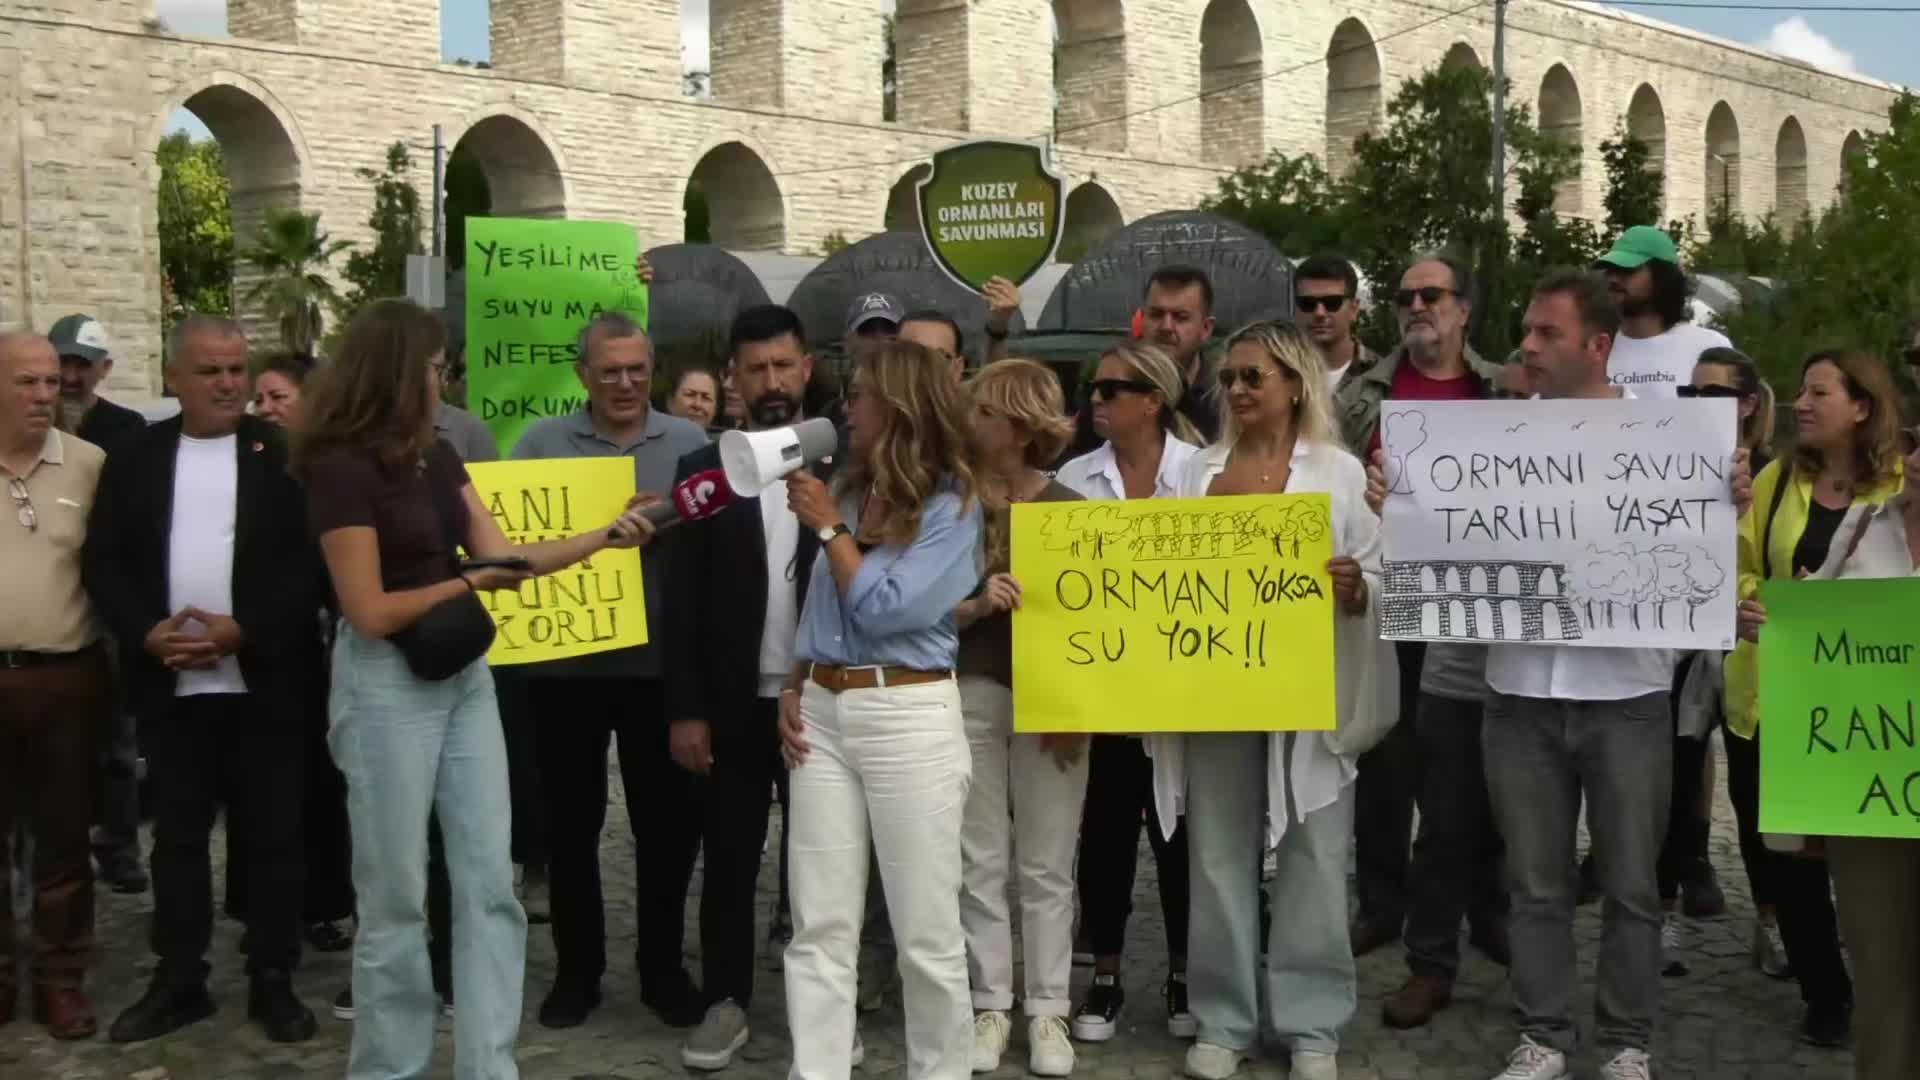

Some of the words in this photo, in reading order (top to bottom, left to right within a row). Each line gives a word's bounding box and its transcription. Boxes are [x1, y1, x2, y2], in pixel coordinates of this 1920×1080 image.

[961, 182, 1018, 201] KUZEY
[938, 201, 1045, 222] ORMANLARI
[939, 220, 1046, 243] SAVUNMASI
[1613, 371, 1676, 385] Columbia
[1430, 452, 1585, 492] ORMANI
[1605, 452, 1724, 482] SAVUN
[1434, 500, 1577, 543] TARİHİ
[1606, 494, 1721, 537] YAŞAT
[1055, 568, 1229, 616] ORMAN
[1066, 626, 1126, 665] SU
[1813, 628, 1915, 666] Mimar
